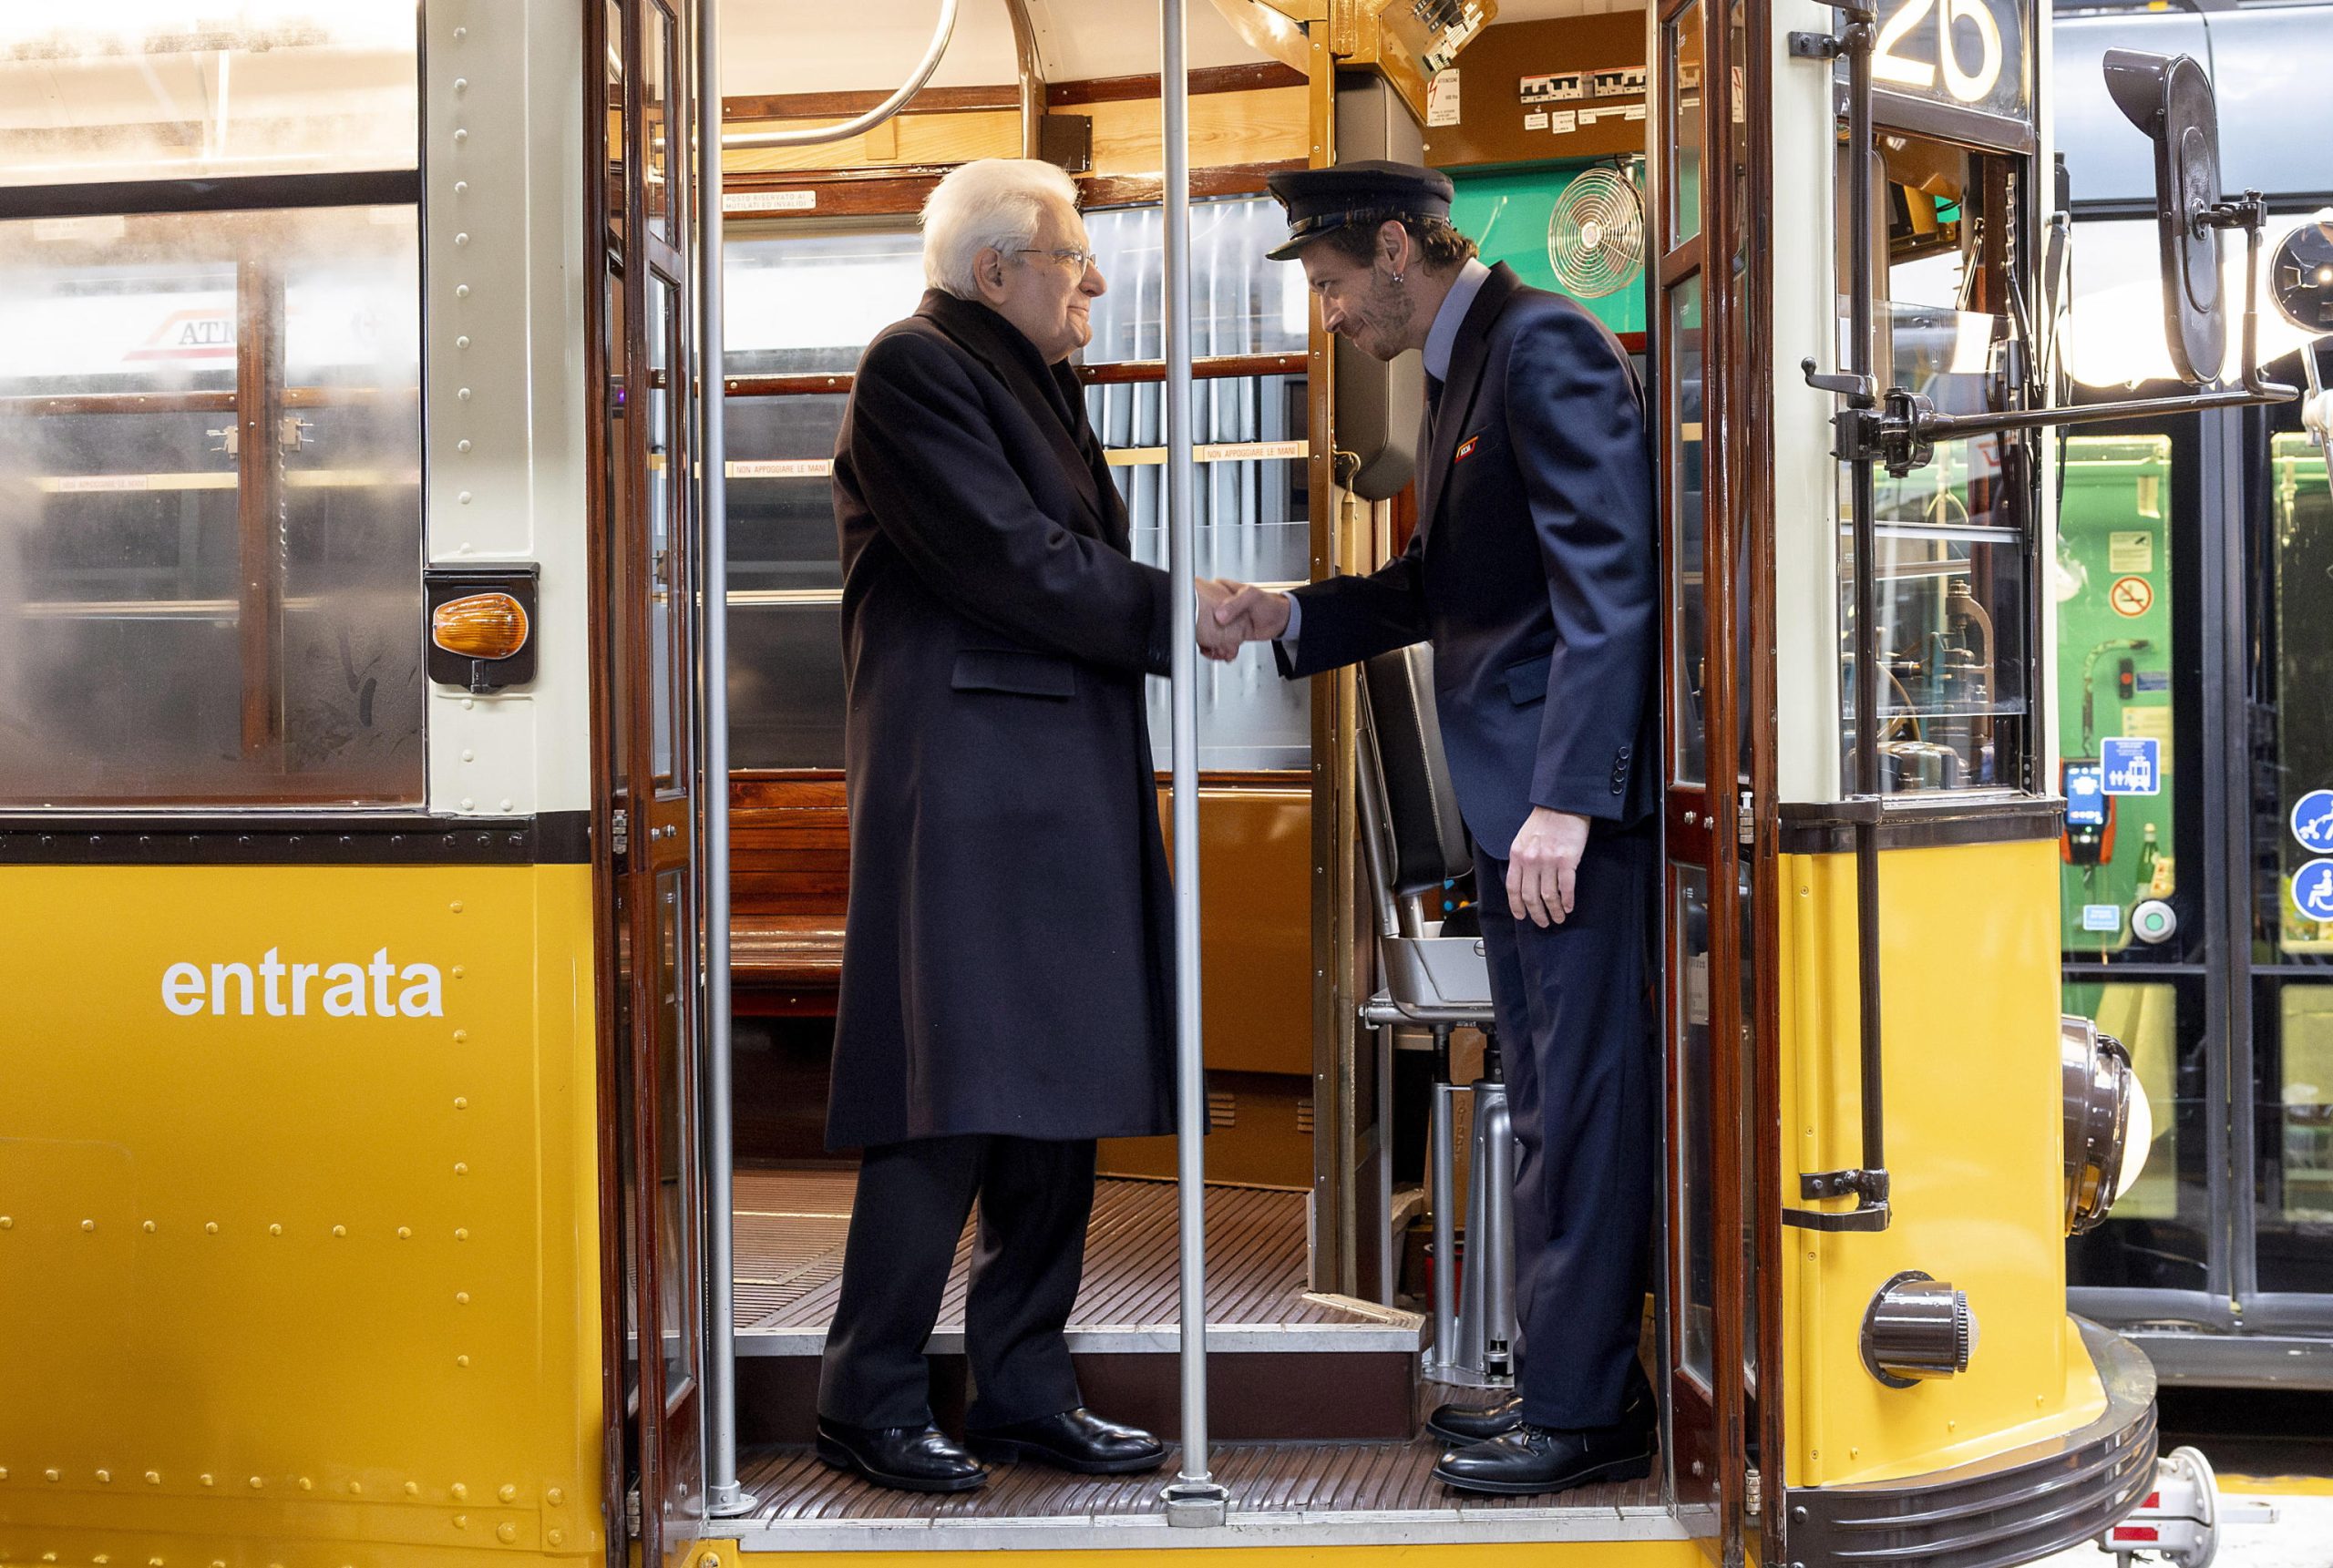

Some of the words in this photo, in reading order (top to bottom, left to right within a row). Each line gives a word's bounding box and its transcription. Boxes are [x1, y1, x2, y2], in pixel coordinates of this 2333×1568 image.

[753, 193, 795, 201] RISERVATO
[1208, 450, 1221, 458] NON
[1225, 447, 1263, 457] APPOGGIARE
[1267, 447, 1273, 456] LE
[1278, 446, 1296, 456] MANI
[736, 466, 751, 474] NON
[754, 465, 794, 474] APPOGGIARE
[797, 465, 804, 473] LE
[161, 947, 444, 1017] entrata
